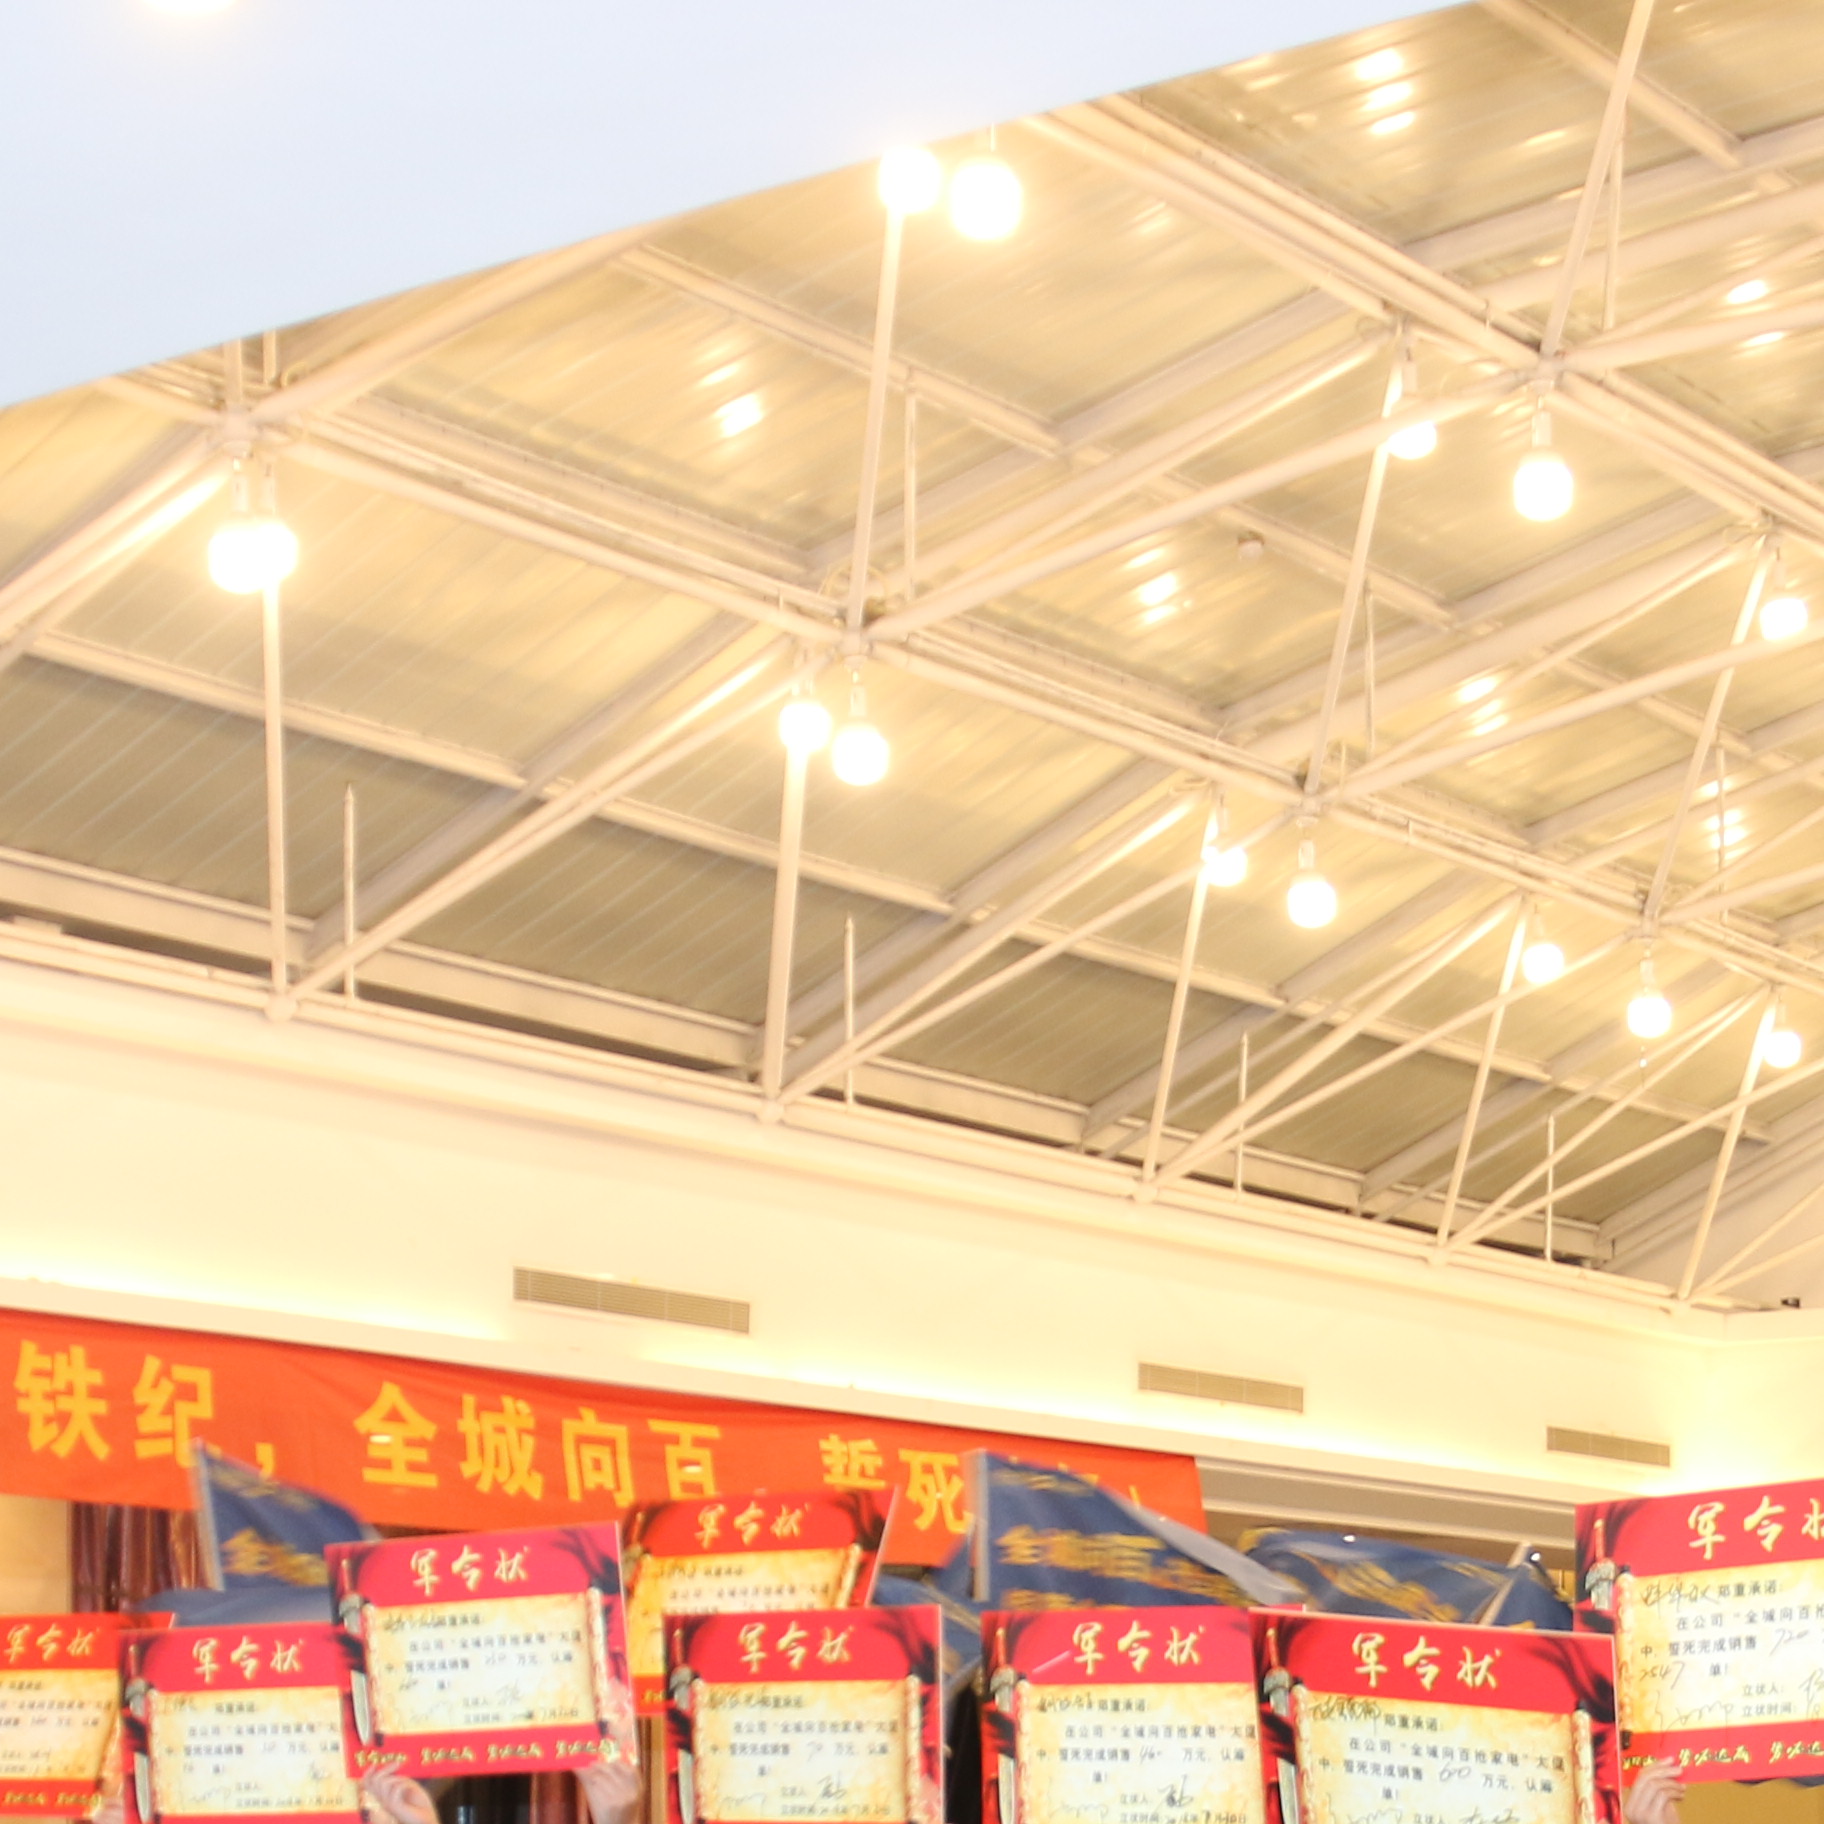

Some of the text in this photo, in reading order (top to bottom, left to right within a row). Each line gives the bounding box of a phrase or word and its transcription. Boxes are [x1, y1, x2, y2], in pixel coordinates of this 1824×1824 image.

[694, 1503, 810, 1549] 军令状
[410, 1545, 530, 1598] 军令状
[3, 1622, 102, 1662] 军令状
[192, 1637, 305, 1684] 军令状
[738, 1620, 855, 1674] 军令状
[1072, 1620, 1206, 1676] 军令状
[1351, 1632, 1502, 1690] 军令状
